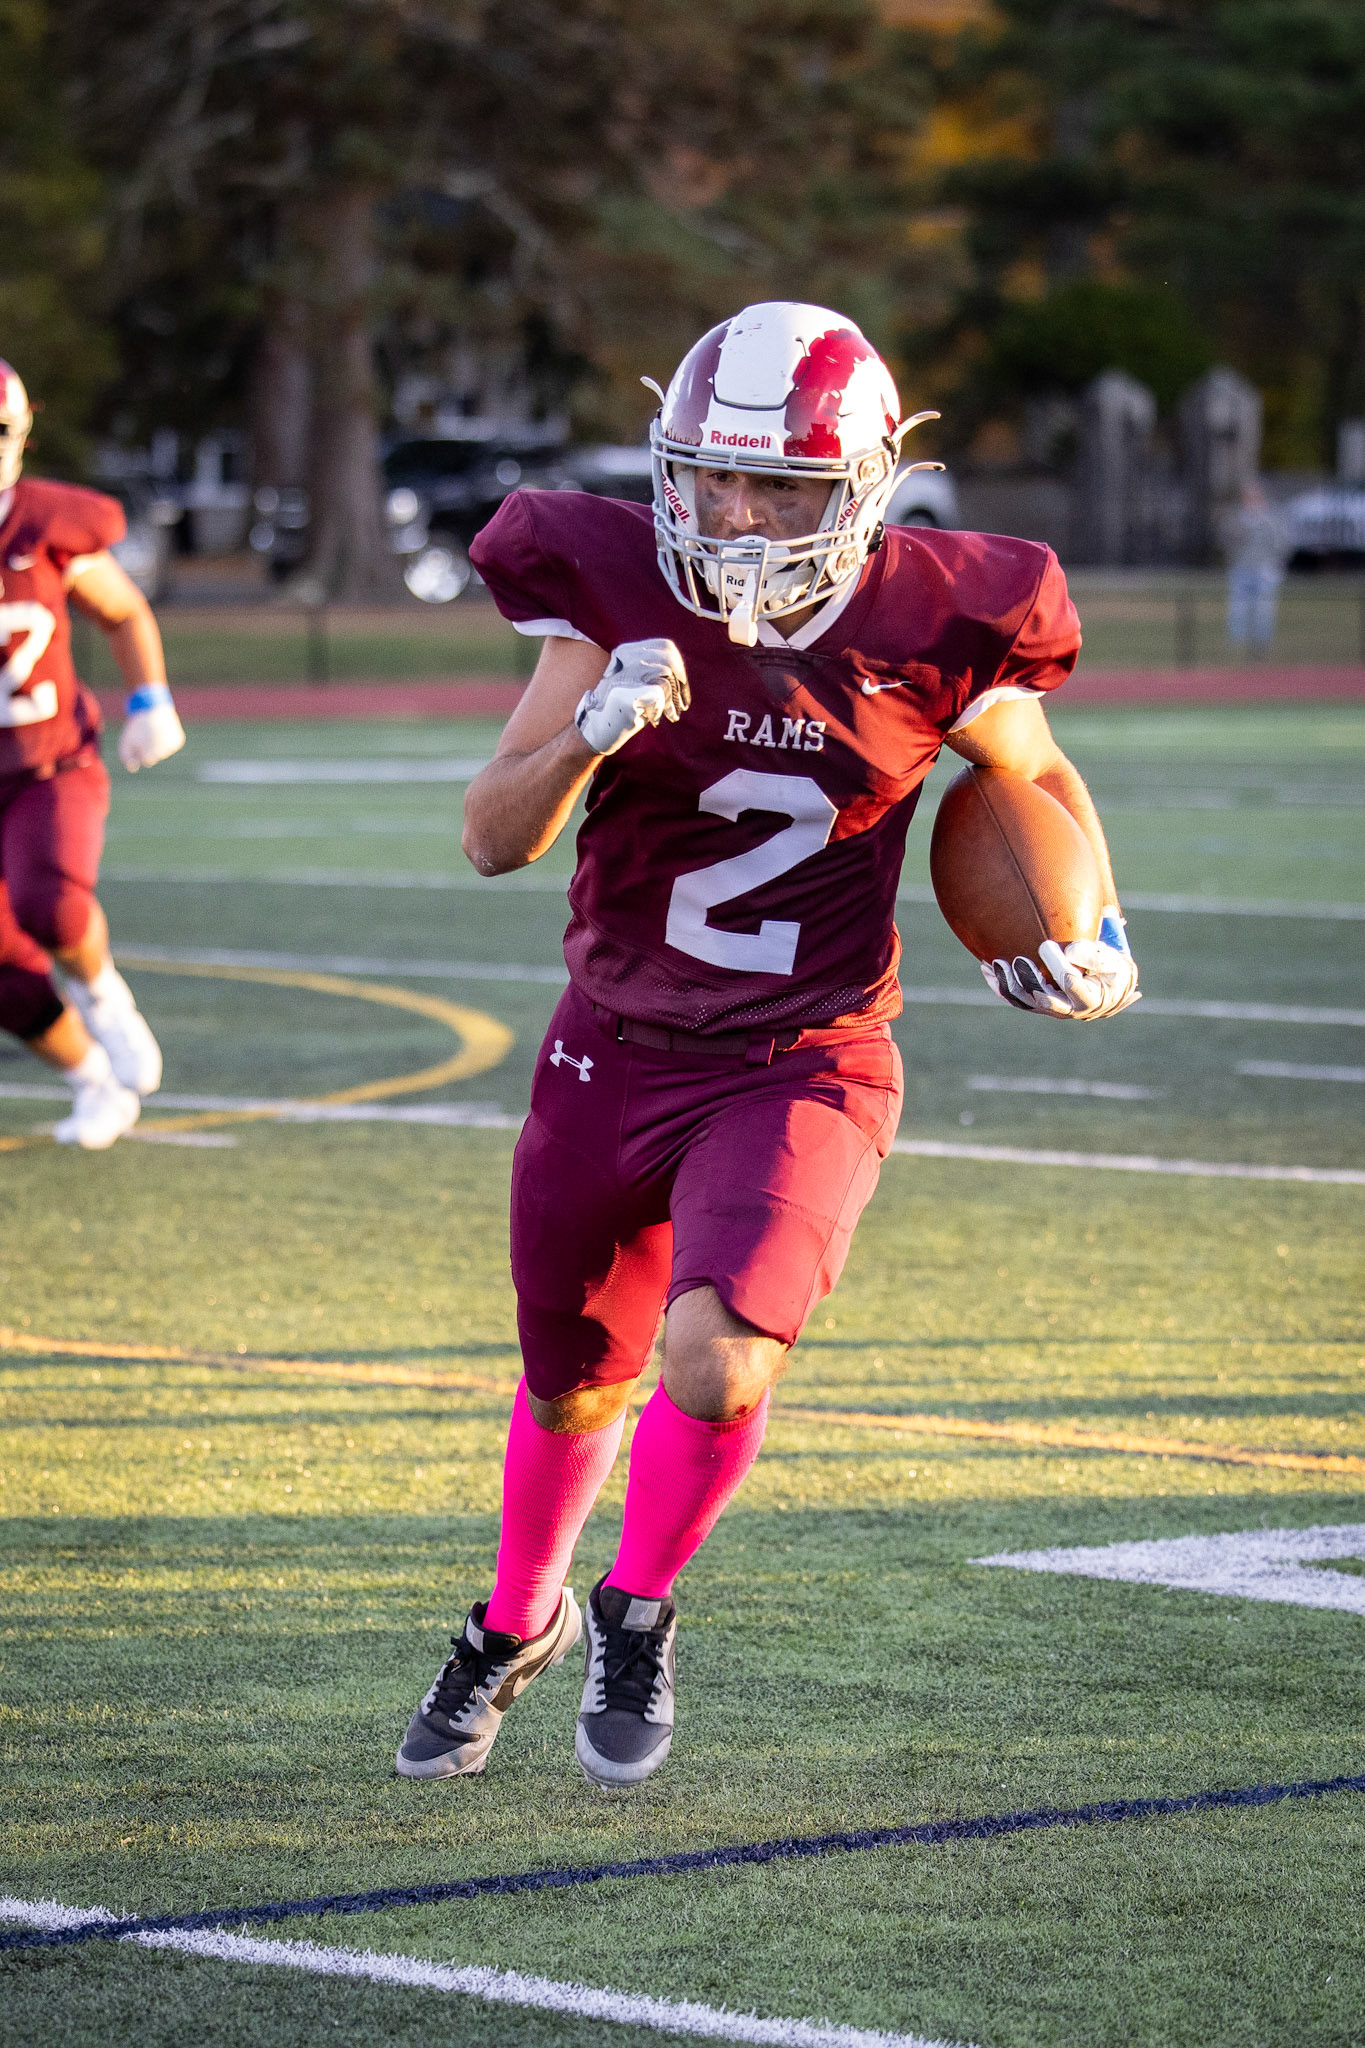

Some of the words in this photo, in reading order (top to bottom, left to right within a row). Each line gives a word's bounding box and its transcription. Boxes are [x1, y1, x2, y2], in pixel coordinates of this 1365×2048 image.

[710, 430, 771, 449] Riddell
[723, 710, 826, 752] RAMS
[665, 768, 839, 976] 2
